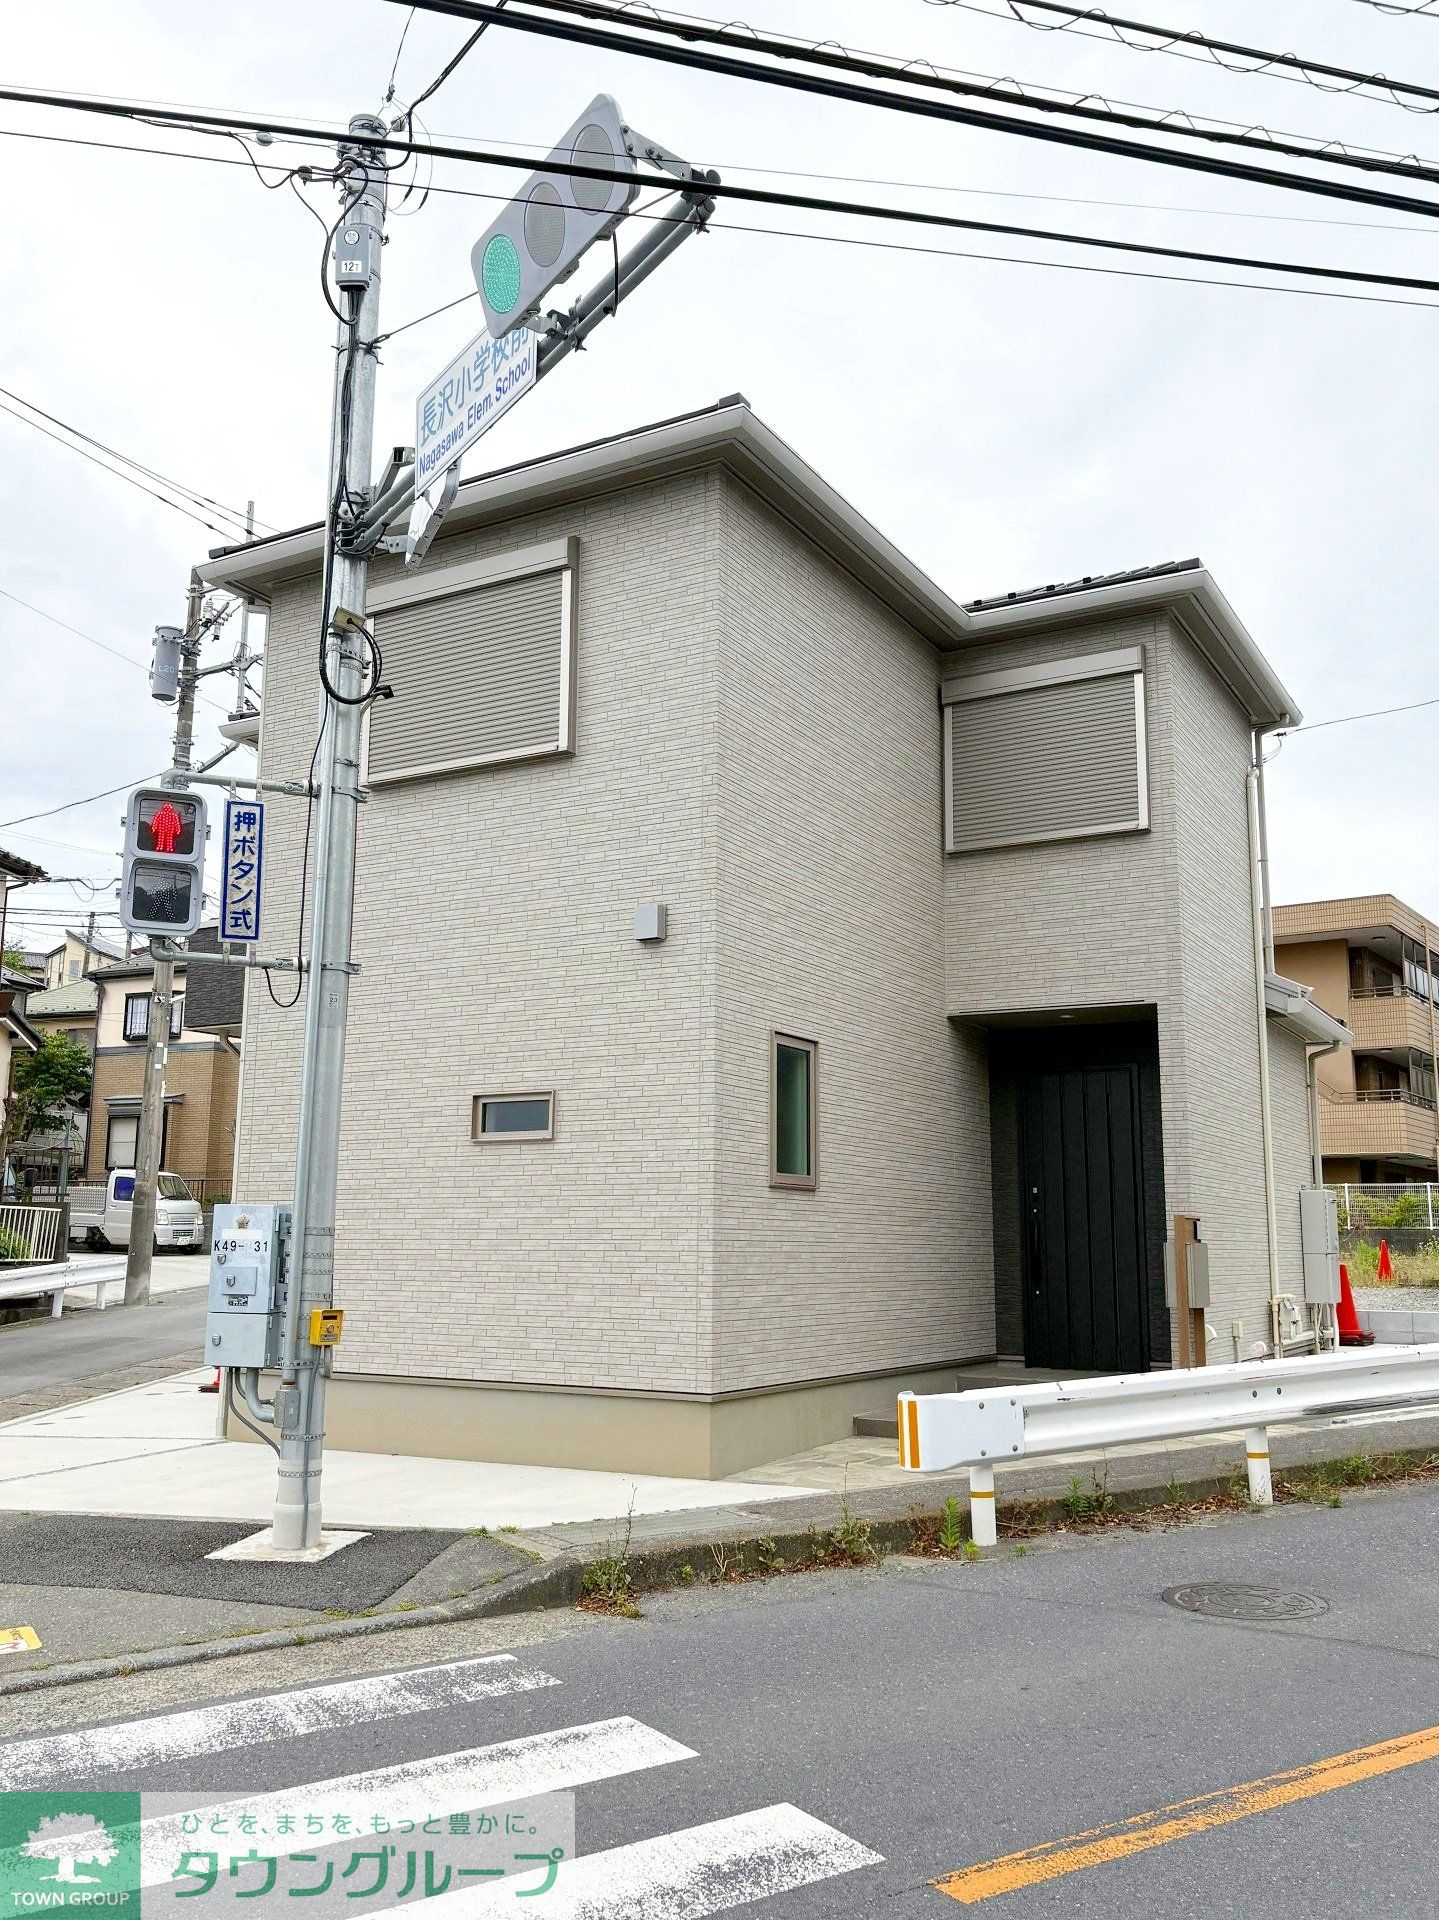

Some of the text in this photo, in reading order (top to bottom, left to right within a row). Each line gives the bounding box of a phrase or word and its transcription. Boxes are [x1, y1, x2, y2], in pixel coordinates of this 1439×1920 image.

[419, 347, 531, 479] Nagasawa Elem. School
[230, 811, 257, 931] 押ボタン式
